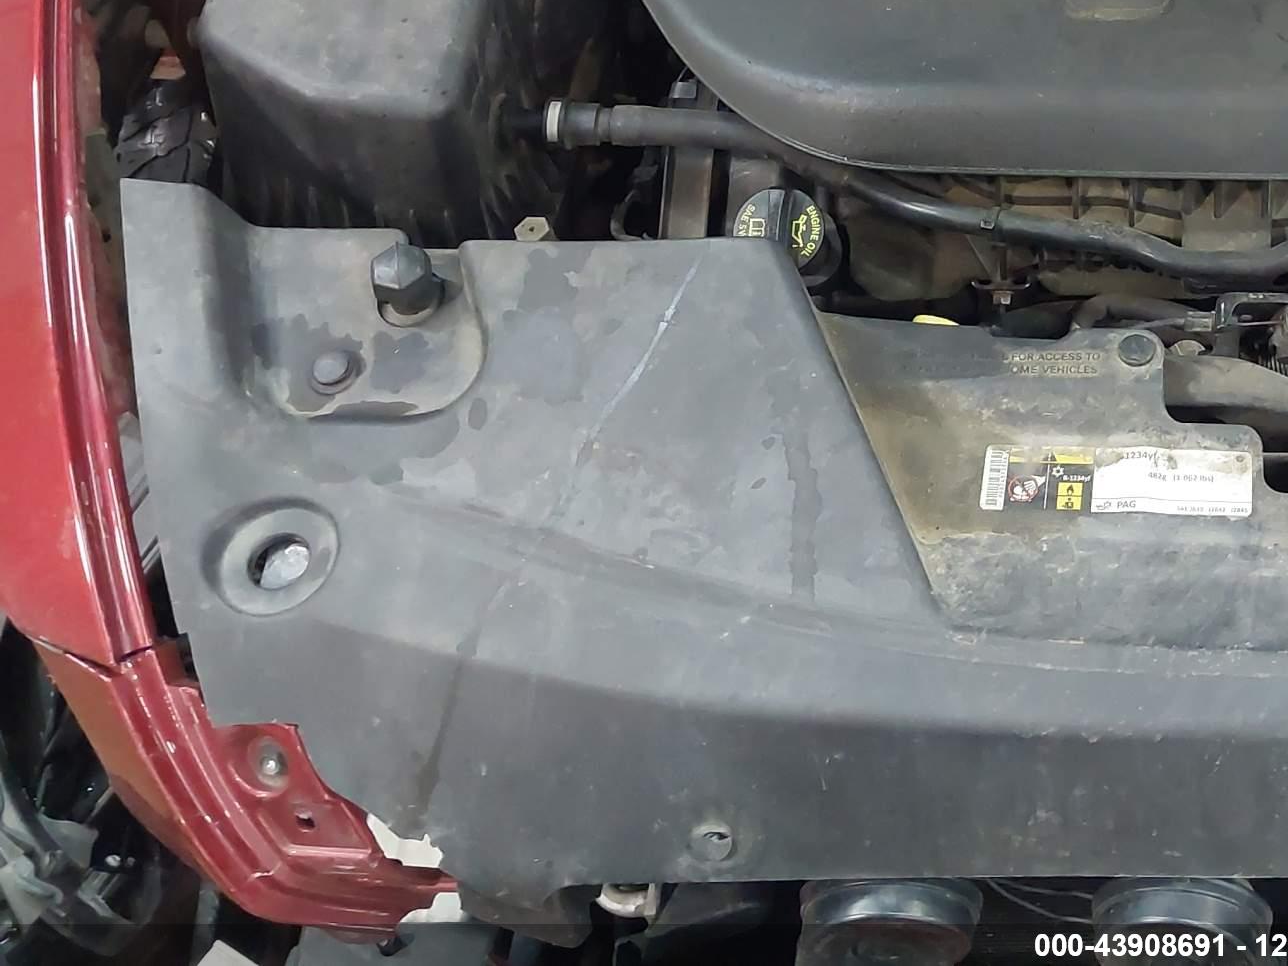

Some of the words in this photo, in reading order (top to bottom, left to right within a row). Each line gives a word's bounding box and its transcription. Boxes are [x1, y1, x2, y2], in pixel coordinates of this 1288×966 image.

[741, 205, 756, 223] SAE
[806, 205, 820, 240] ENGINE
[801, 242, 816, 257] OIL
[1011, 352, 1034, 362] FOR
[1038, 352, 1082, 362] ACCESS
[1085, 352, 1101, 361] TO
[1010, 365, 1038, 375] OME
[1042, 365, 1098, 375] VEHICLES
[1147, 472, 1168, 482] 482g
[1117, 500, 1136, 509] PAG
